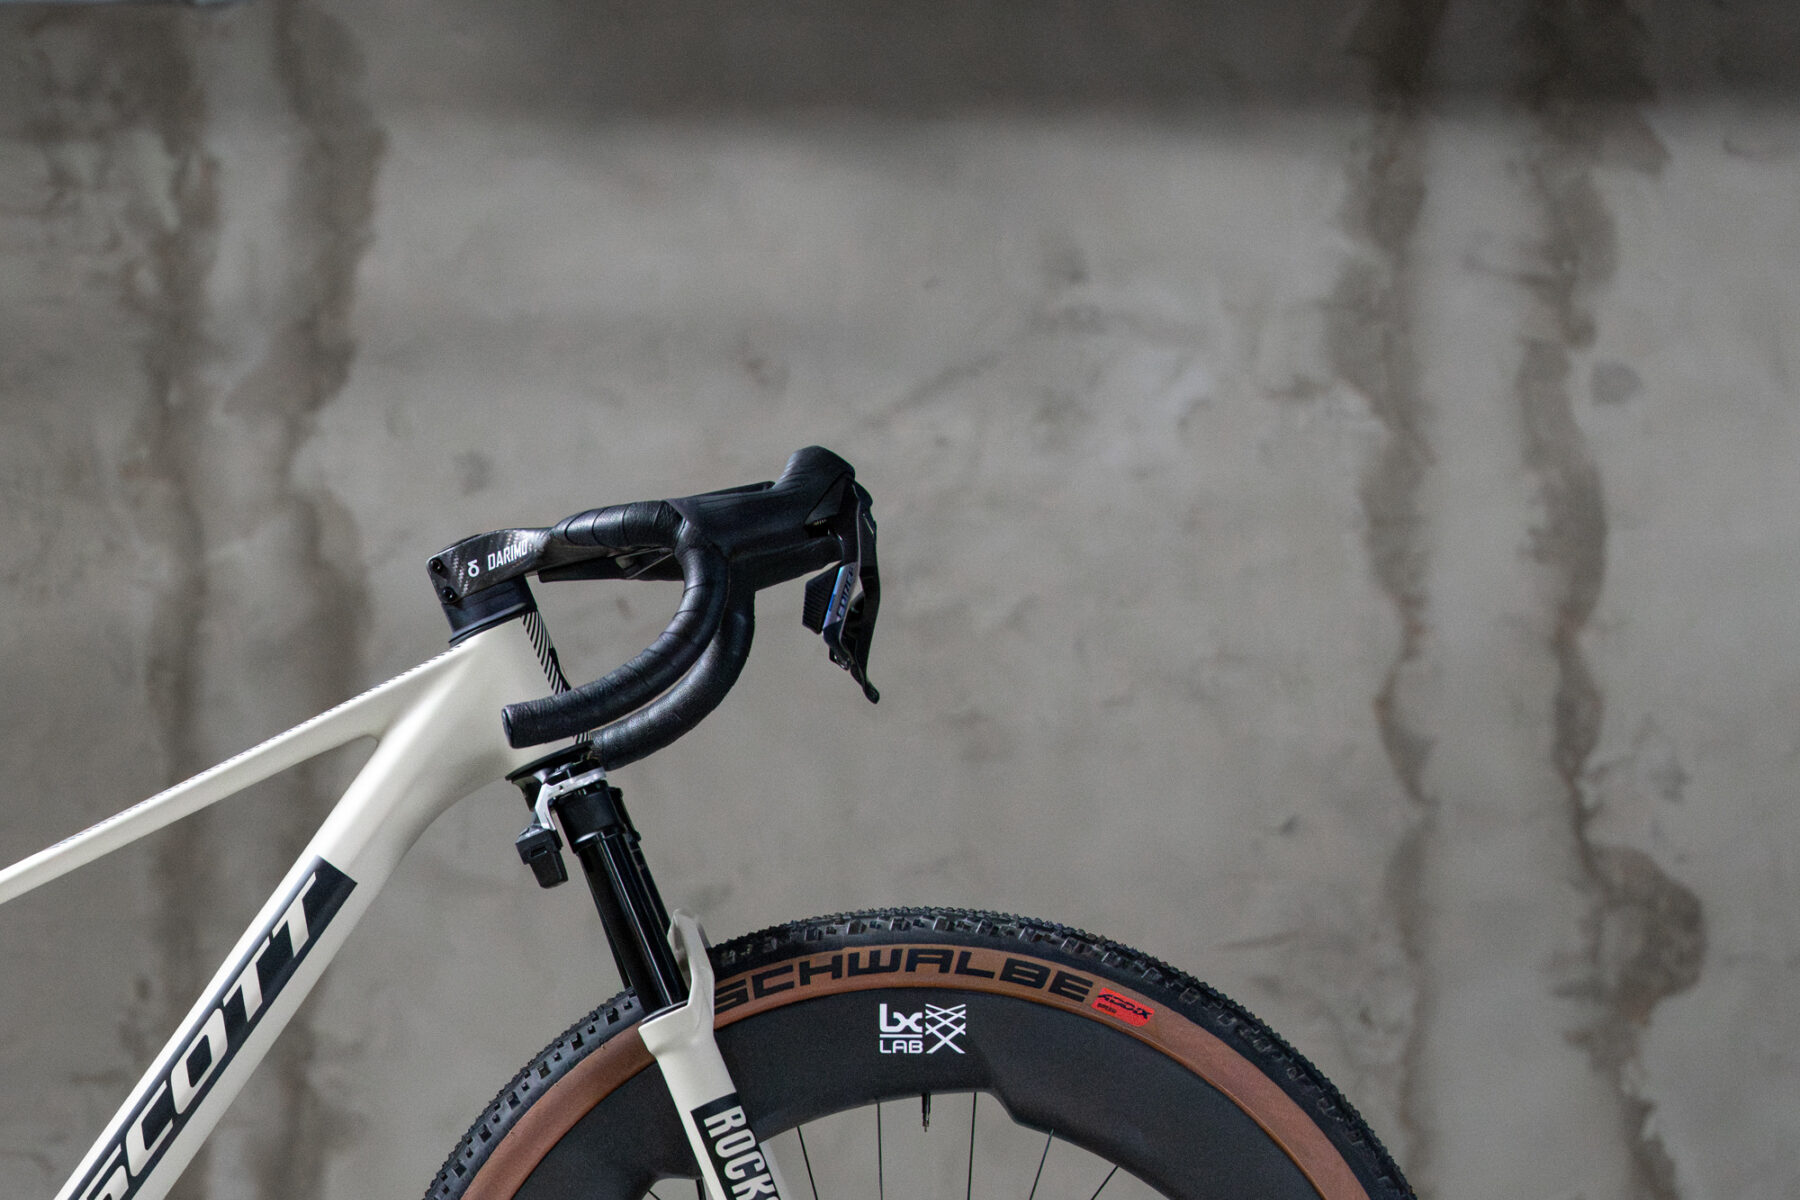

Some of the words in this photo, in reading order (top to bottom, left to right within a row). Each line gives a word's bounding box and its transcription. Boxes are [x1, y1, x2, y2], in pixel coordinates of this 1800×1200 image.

[487, 540, 528, 571] DARIMO
[714, 949, 1093, 1016] SCHWALBE
[879, 1040, 923, 1054] LAB
